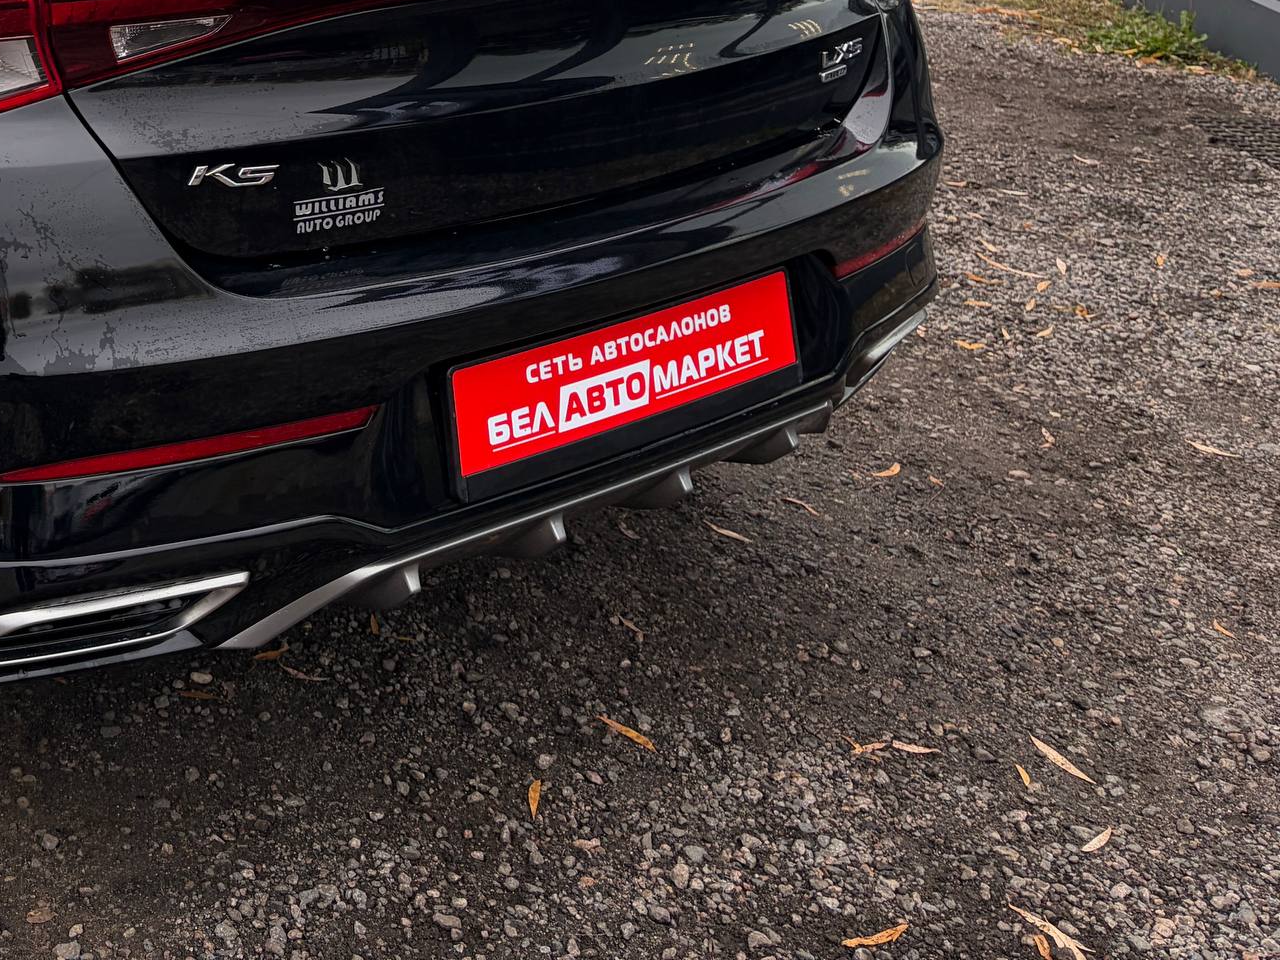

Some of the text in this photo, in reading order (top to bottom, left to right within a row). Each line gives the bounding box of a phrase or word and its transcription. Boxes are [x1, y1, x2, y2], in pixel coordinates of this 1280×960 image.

[187, 163, 281, 187] K5
[295, 191, 384, 216] WILLIAMS
[296, 209, 381, 234] AUTO GROUP
[525, 304, 732, 384] СЕТЬ АВТОСАЛОНОВ
